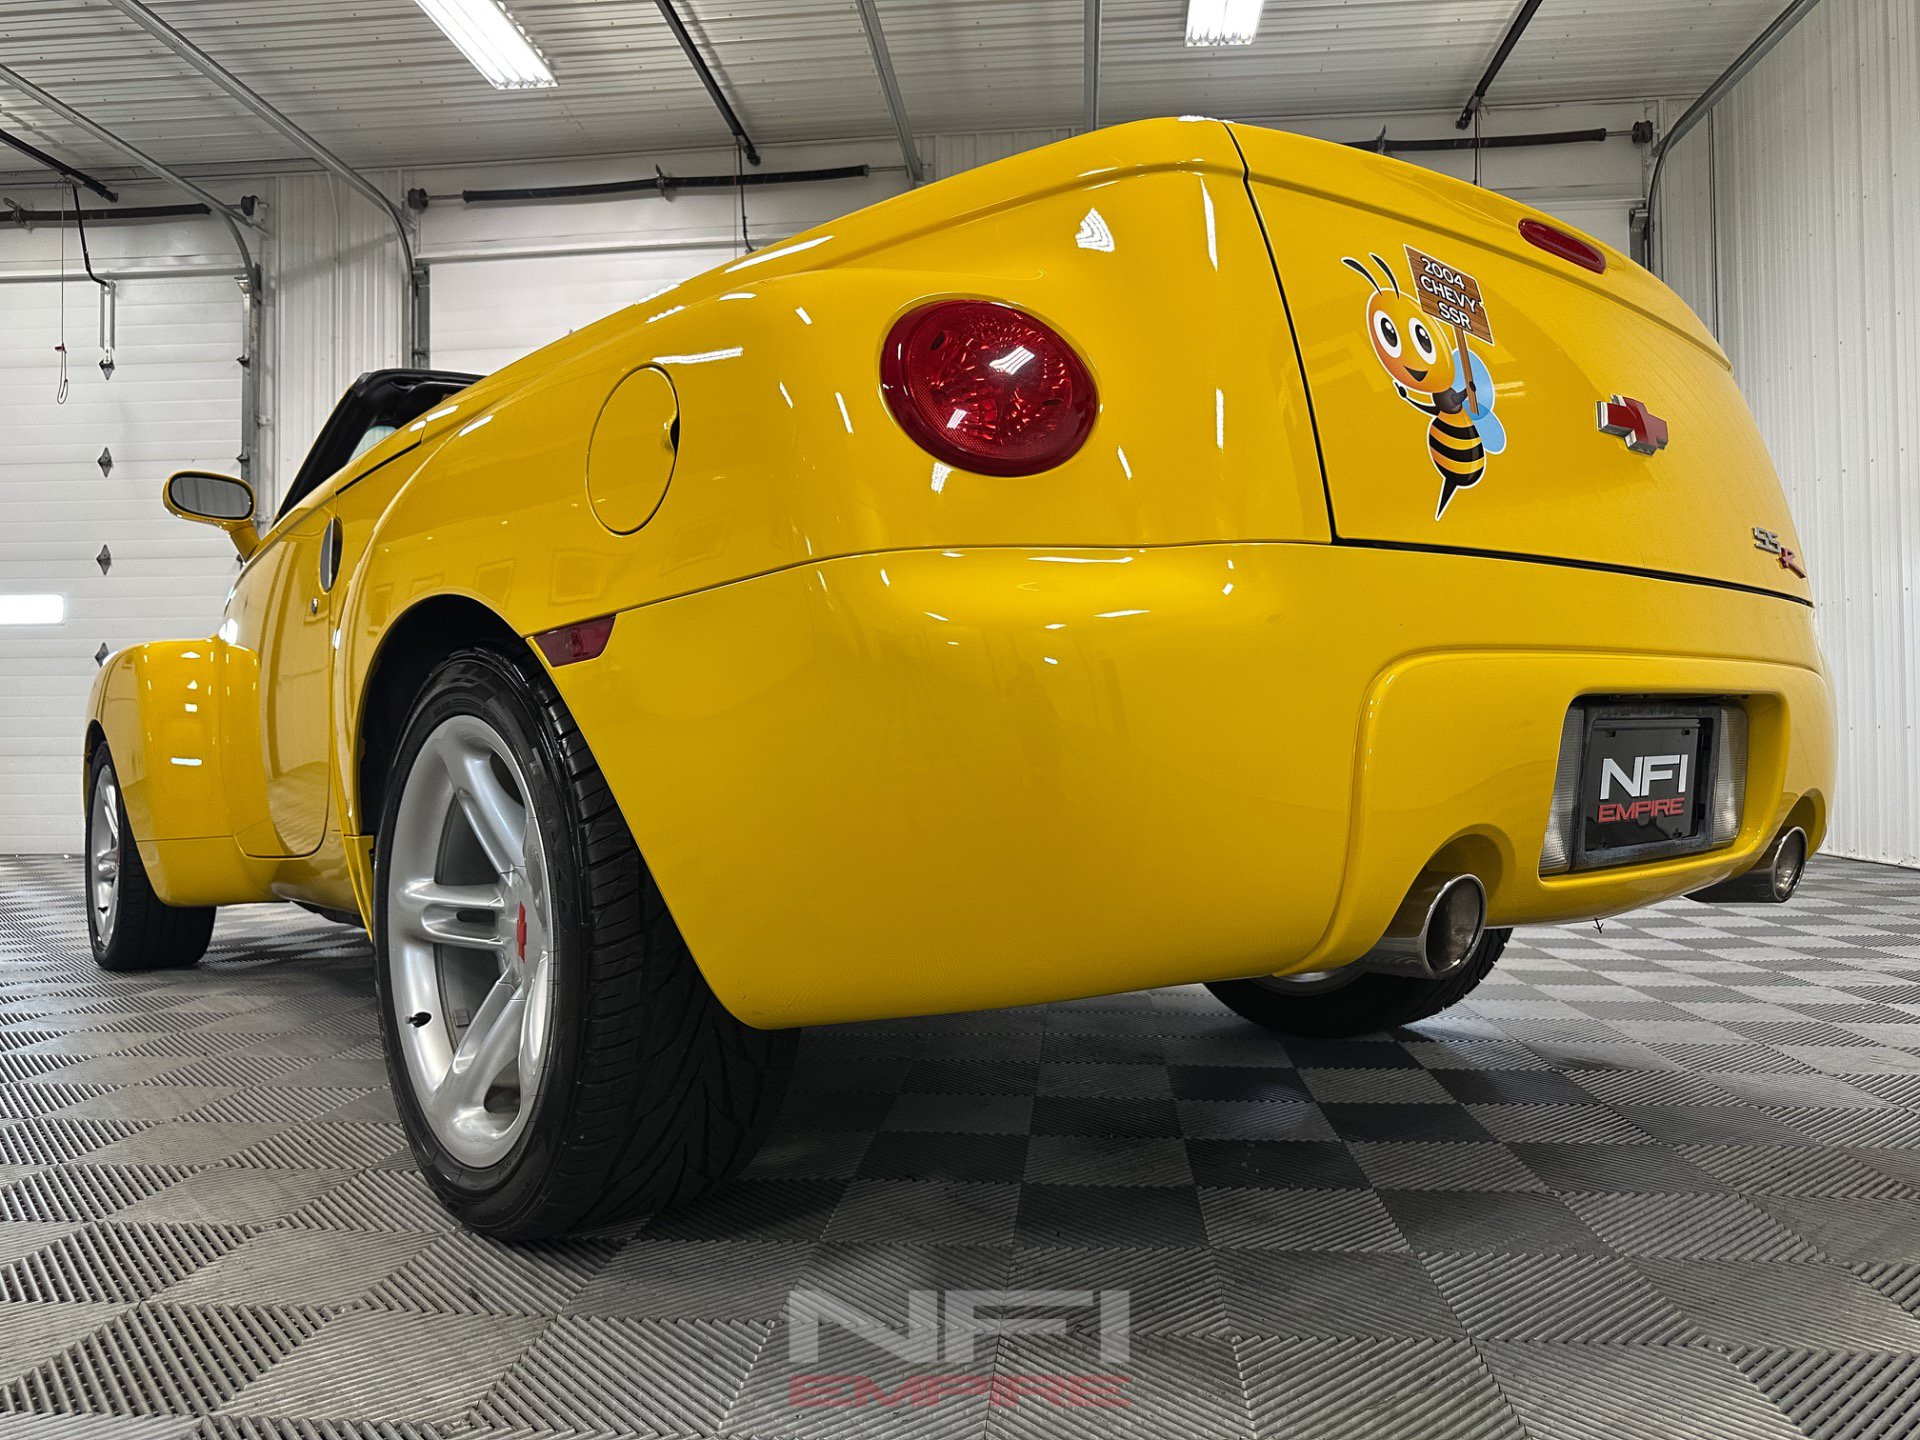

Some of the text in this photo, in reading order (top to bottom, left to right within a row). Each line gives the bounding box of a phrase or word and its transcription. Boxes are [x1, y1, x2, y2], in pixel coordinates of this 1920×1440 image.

[1421, 257, 1465, 289] 2004
[1420, 275, 1477, 313] CHEVY
[1438, 302, 1472, 331] SSR
[1600, 754, 1688, 800] NFI
[1599, 797, 1685, 823] EMPIRE
